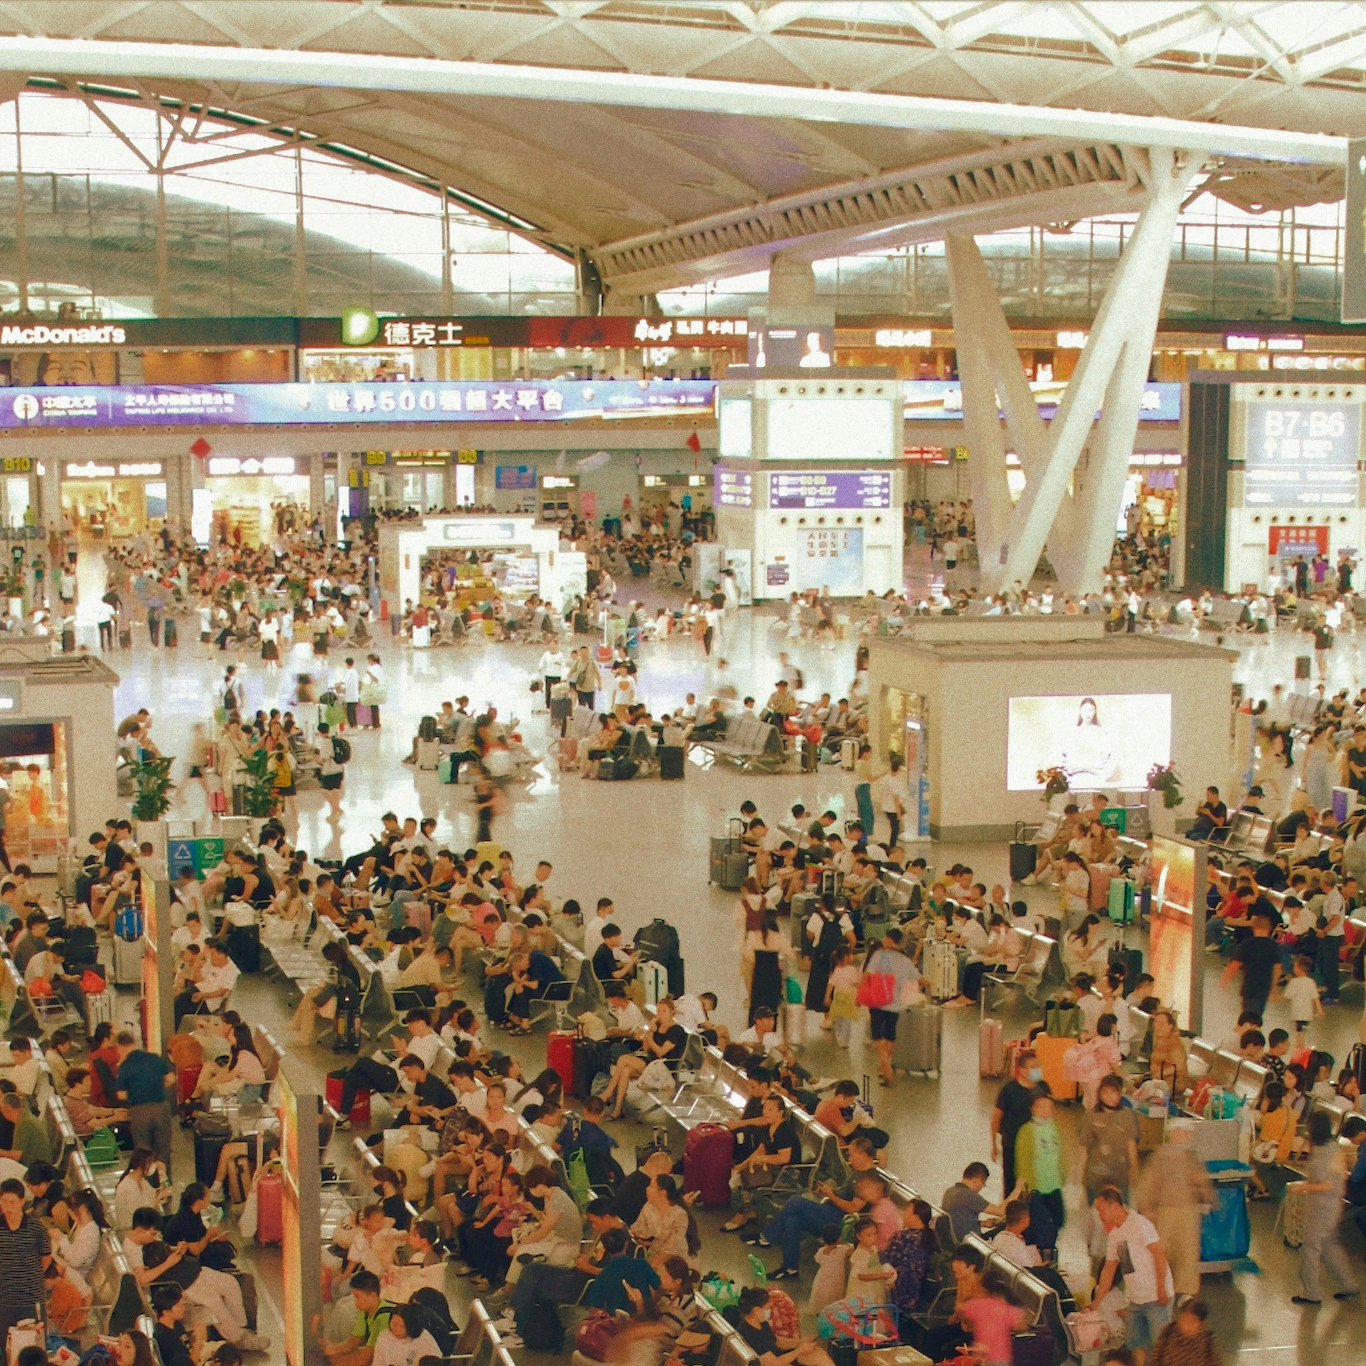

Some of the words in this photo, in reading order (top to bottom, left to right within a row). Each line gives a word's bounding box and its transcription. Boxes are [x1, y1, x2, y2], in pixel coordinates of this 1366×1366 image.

[1, 325, 126, 345] McDonald's
[384, 321, 463, 346] 德克士
[4, 457, 31, 472] B10
